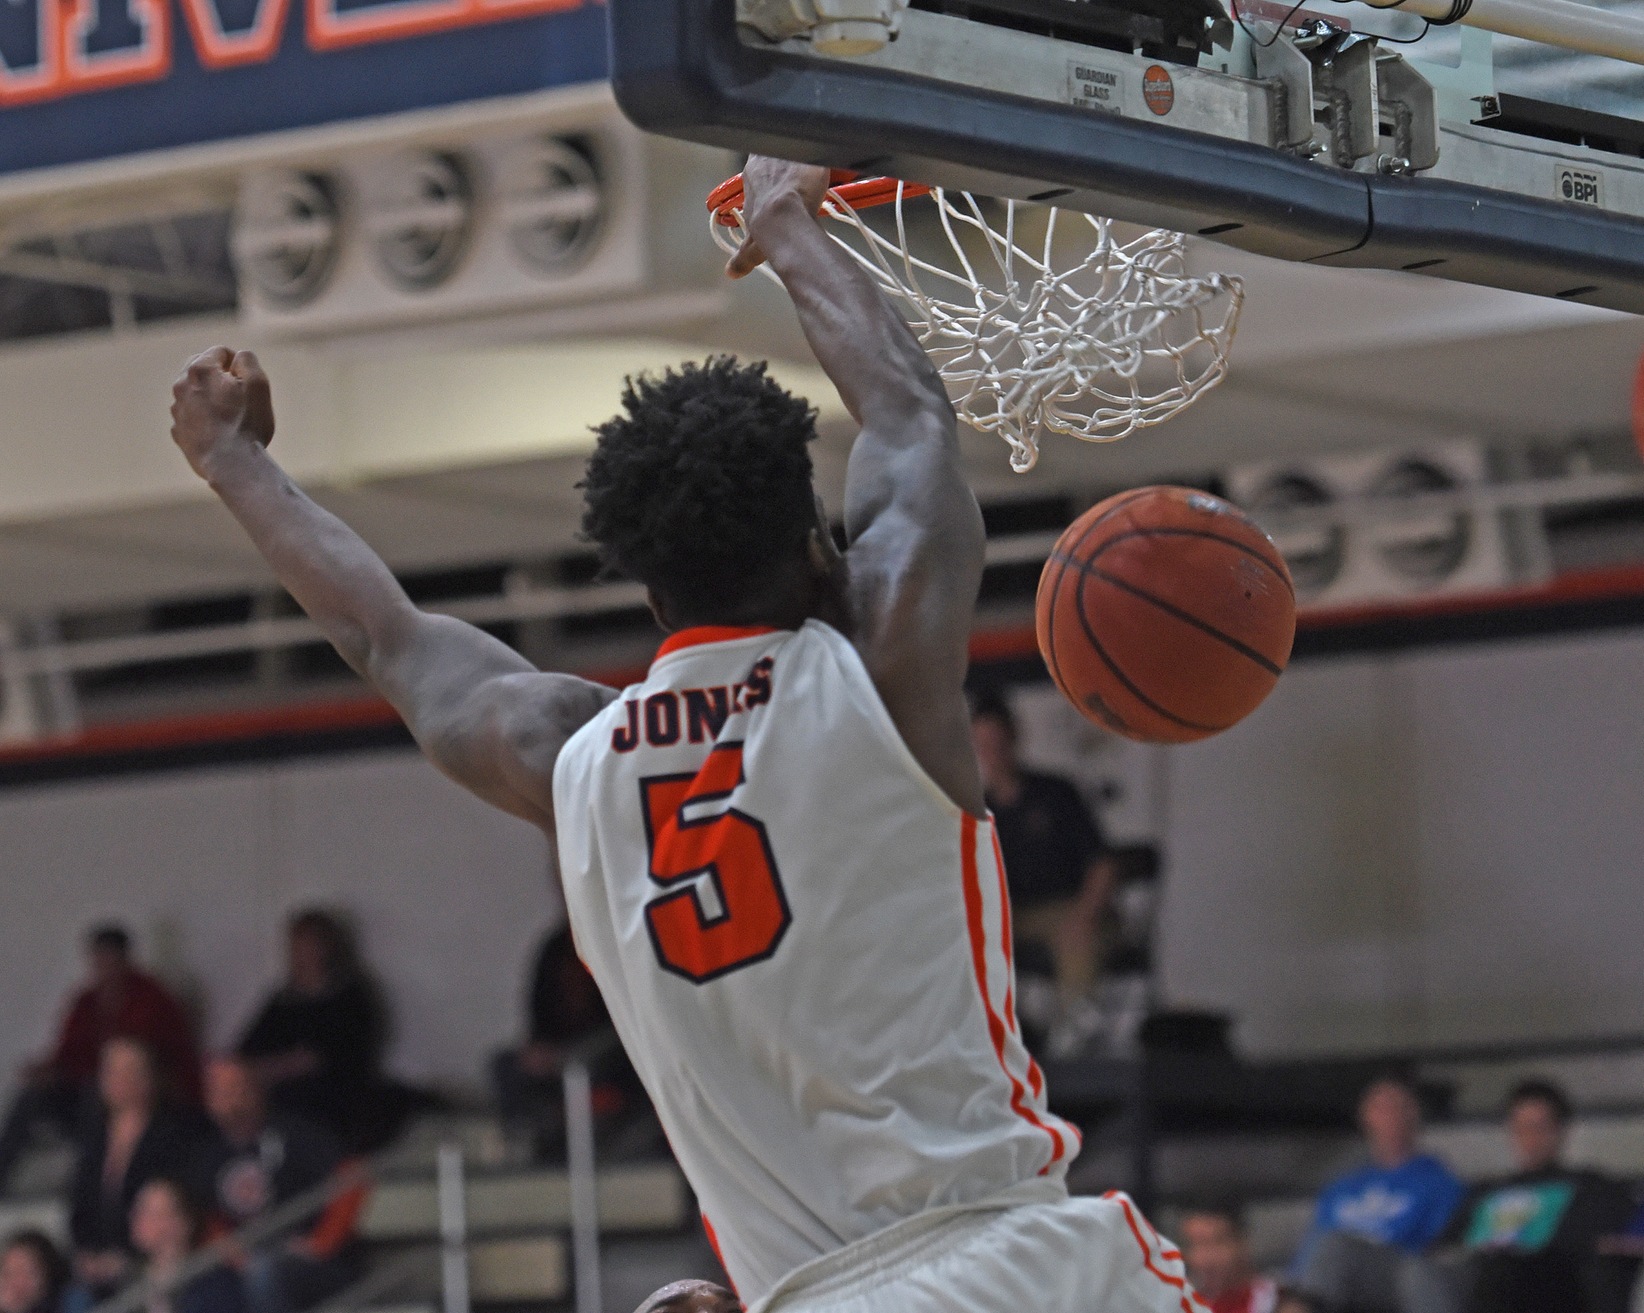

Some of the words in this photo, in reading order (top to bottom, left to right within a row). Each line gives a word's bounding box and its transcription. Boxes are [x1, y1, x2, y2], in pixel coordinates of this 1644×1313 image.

[1075, 66, 1117, 87] GUARDIAN
[1083, 84, 1110, 101] GLASS
[1573, 181, 1598, 203] BPI
[638, 740, 793, 986] 5
